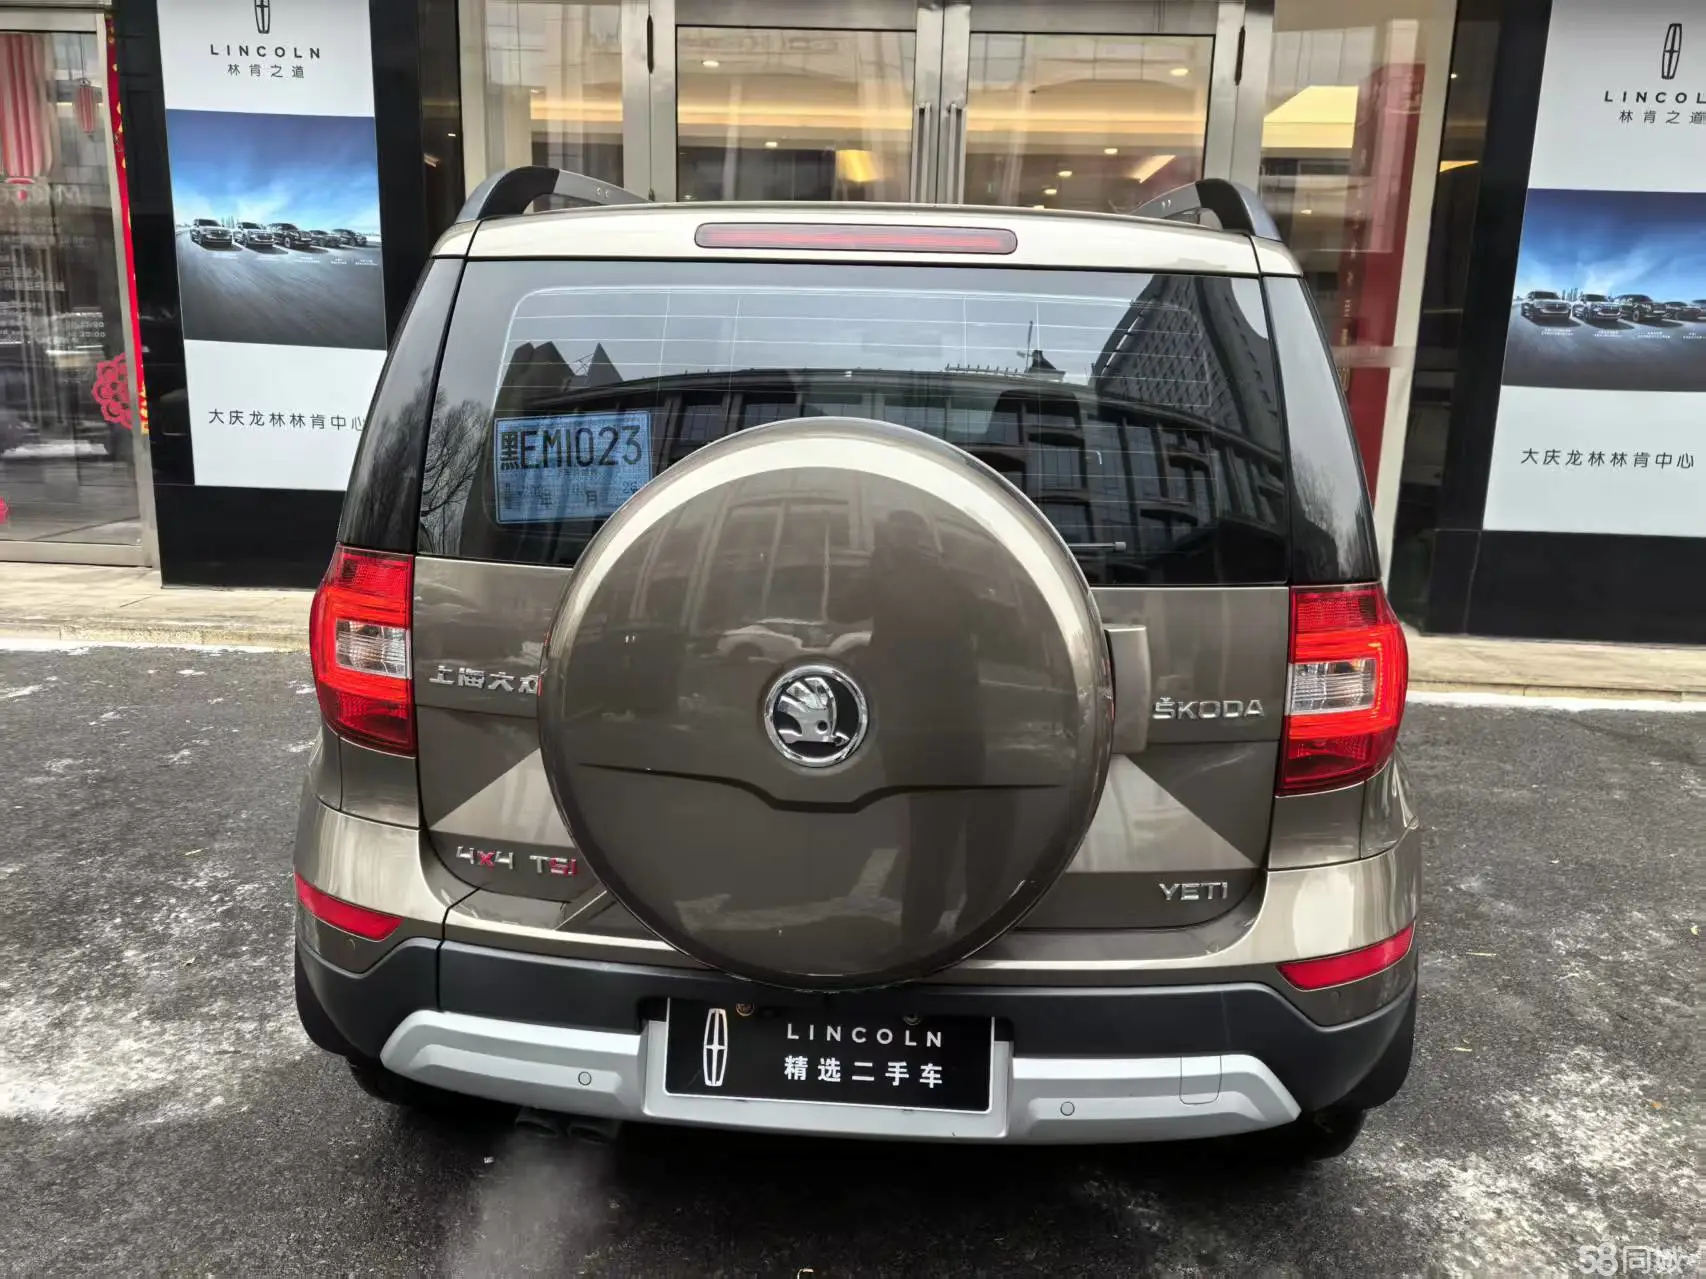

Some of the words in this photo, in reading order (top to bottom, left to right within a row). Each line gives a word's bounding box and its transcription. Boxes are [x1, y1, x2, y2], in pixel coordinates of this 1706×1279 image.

[210, 44, 320, 59] LINCOLN
[227, 63, 304, 79] 林肯之道
[1619, 109, 1706, 125] 林肯之道
[208, 408, 364, 432] 大庆龙林林肯中心
[1520, 448, 1694, 469] 大庆龙林林肯中心
[1152, 696, 1265, 719] ŠKODA
[1159, 882, 1228, 900] YETI
[787, 1023, 942, 1047] LINCOLN
[784, 1055, 943, 1088] 精选二手车
